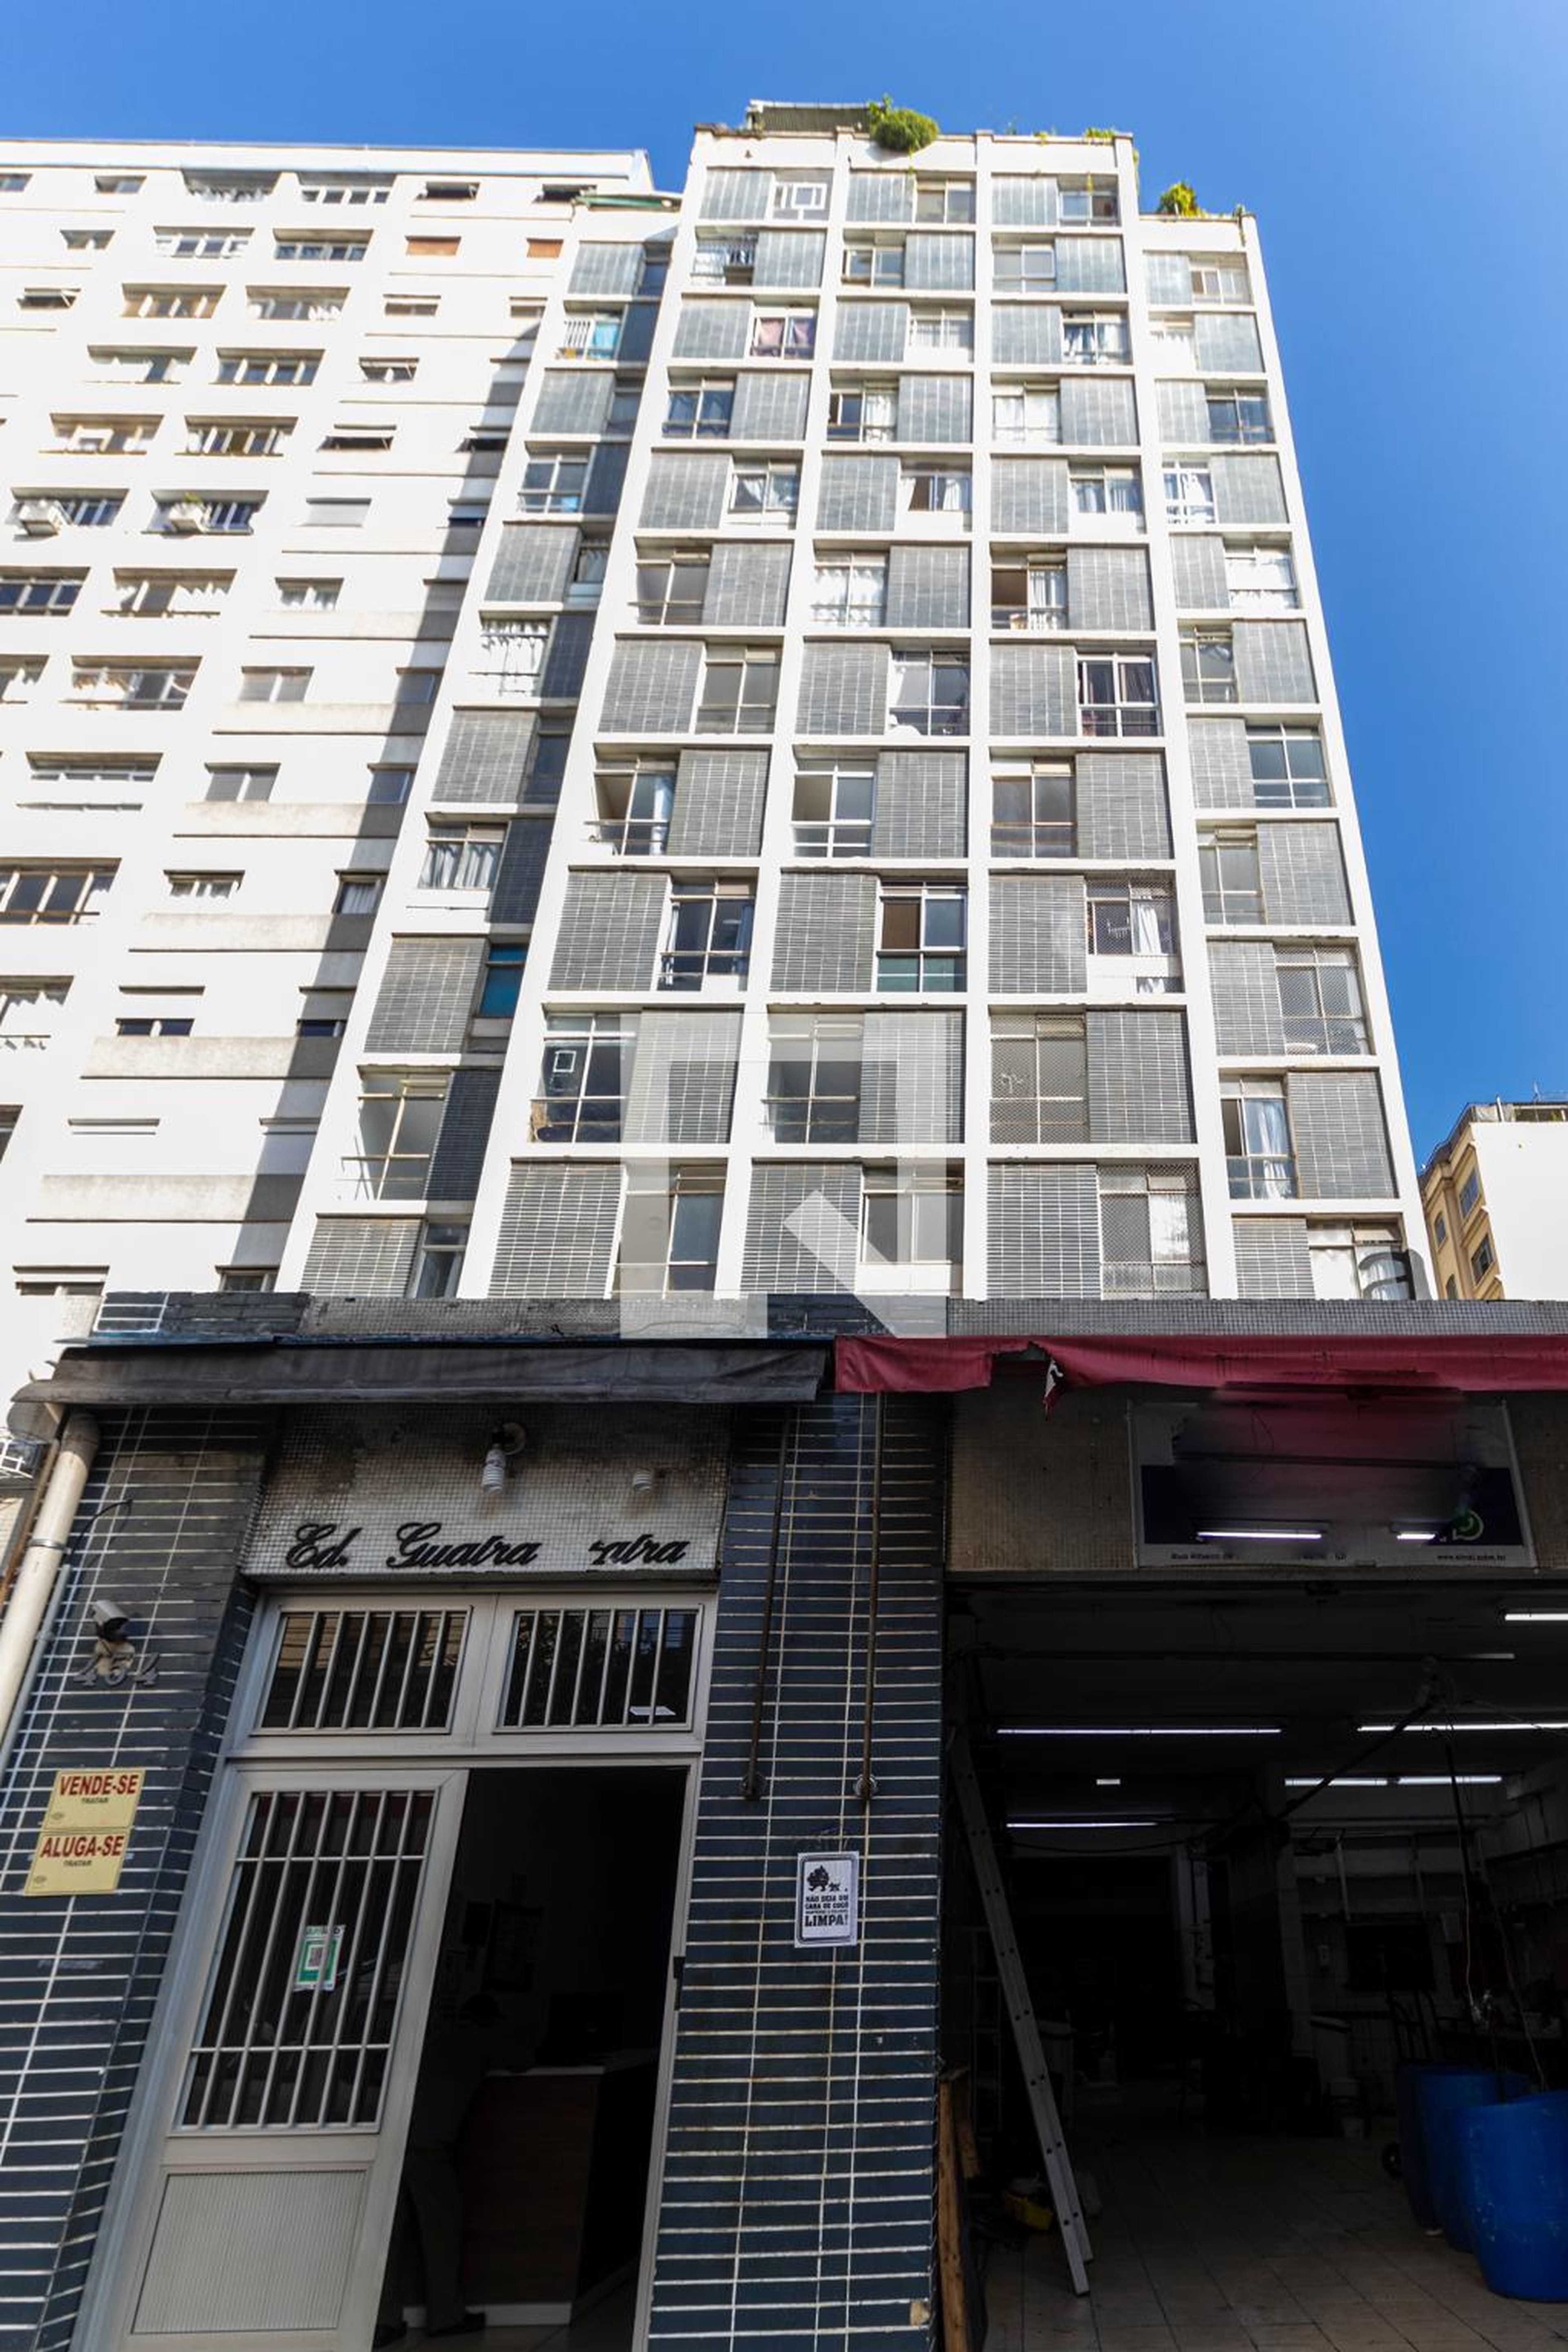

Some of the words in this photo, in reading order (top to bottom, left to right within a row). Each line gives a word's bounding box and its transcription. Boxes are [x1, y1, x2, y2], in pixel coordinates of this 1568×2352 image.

[60, 1774, 138, 1796] VENDE-SE
[40, 1835, 125, 1858] ALUGA-SE
[804, 1914, 849, 1927] LIMPA!
